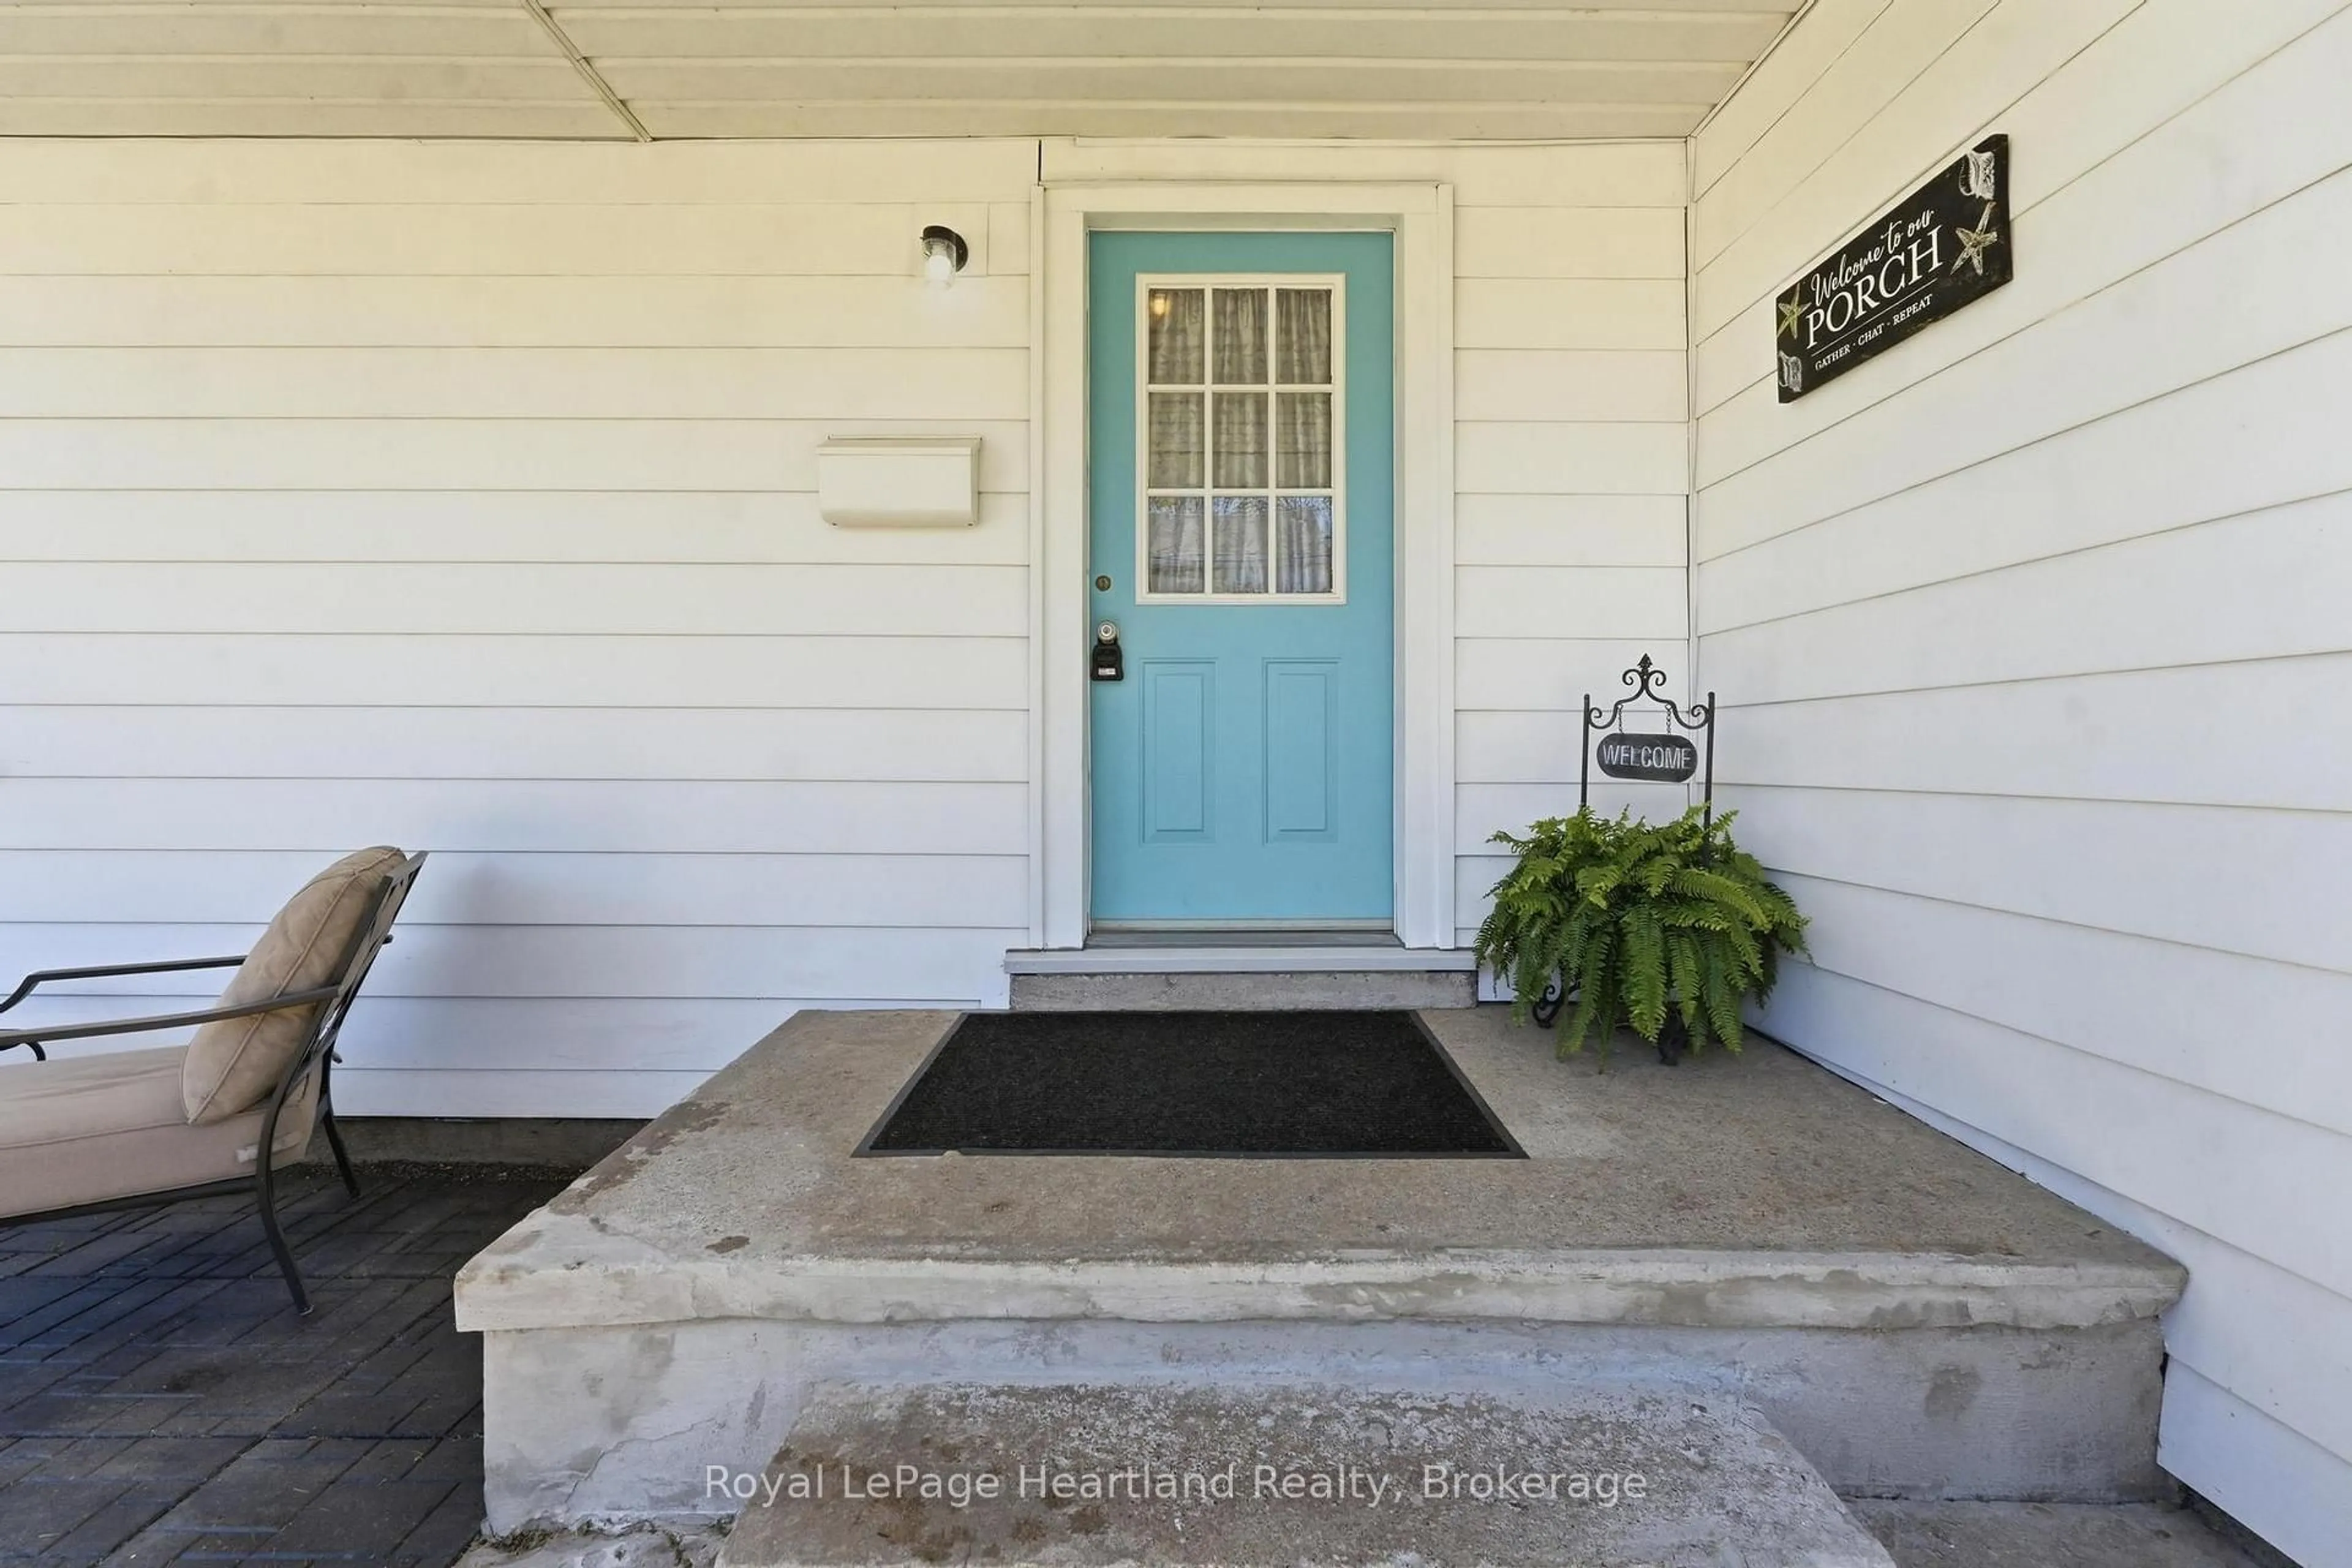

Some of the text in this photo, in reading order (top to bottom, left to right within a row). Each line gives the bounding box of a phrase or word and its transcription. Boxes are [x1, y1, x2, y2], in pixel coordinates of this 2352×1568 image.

[1806, 224, 1943, 350] PORCH
[1811, 209, 1935, 306] Welcome to our
[1815, 293, 1933, 371] GATHER CHAT REPEAT
[1602, 744, 1693, 769] WELCOME
